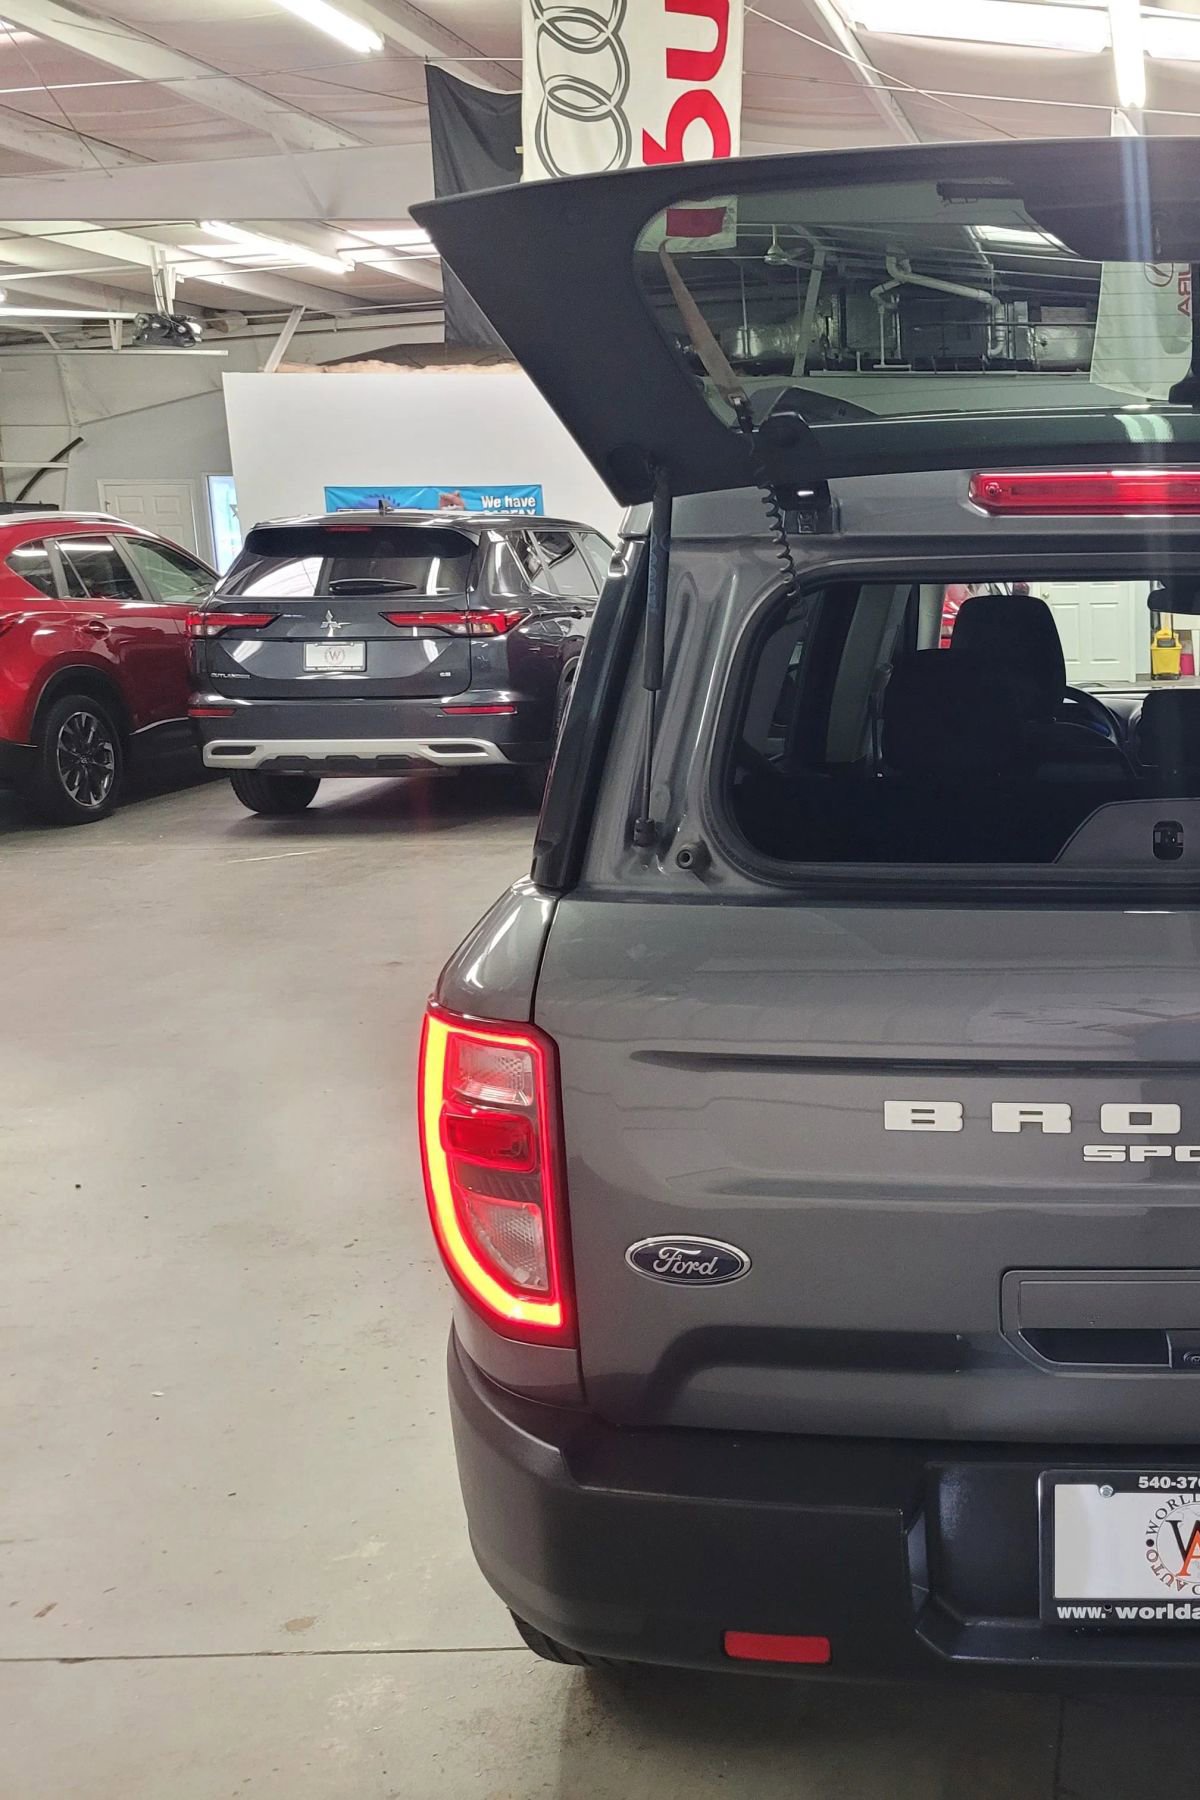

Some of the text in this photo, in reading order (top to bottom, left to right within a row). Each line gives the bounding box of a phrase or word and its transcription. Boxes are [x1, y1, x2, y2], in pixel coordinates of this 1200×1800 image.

[481, 495, 536, 508] We have
[652, 1246, 719, 1276] Ford
[1146, 1549, 1188, 1592] AUTO
